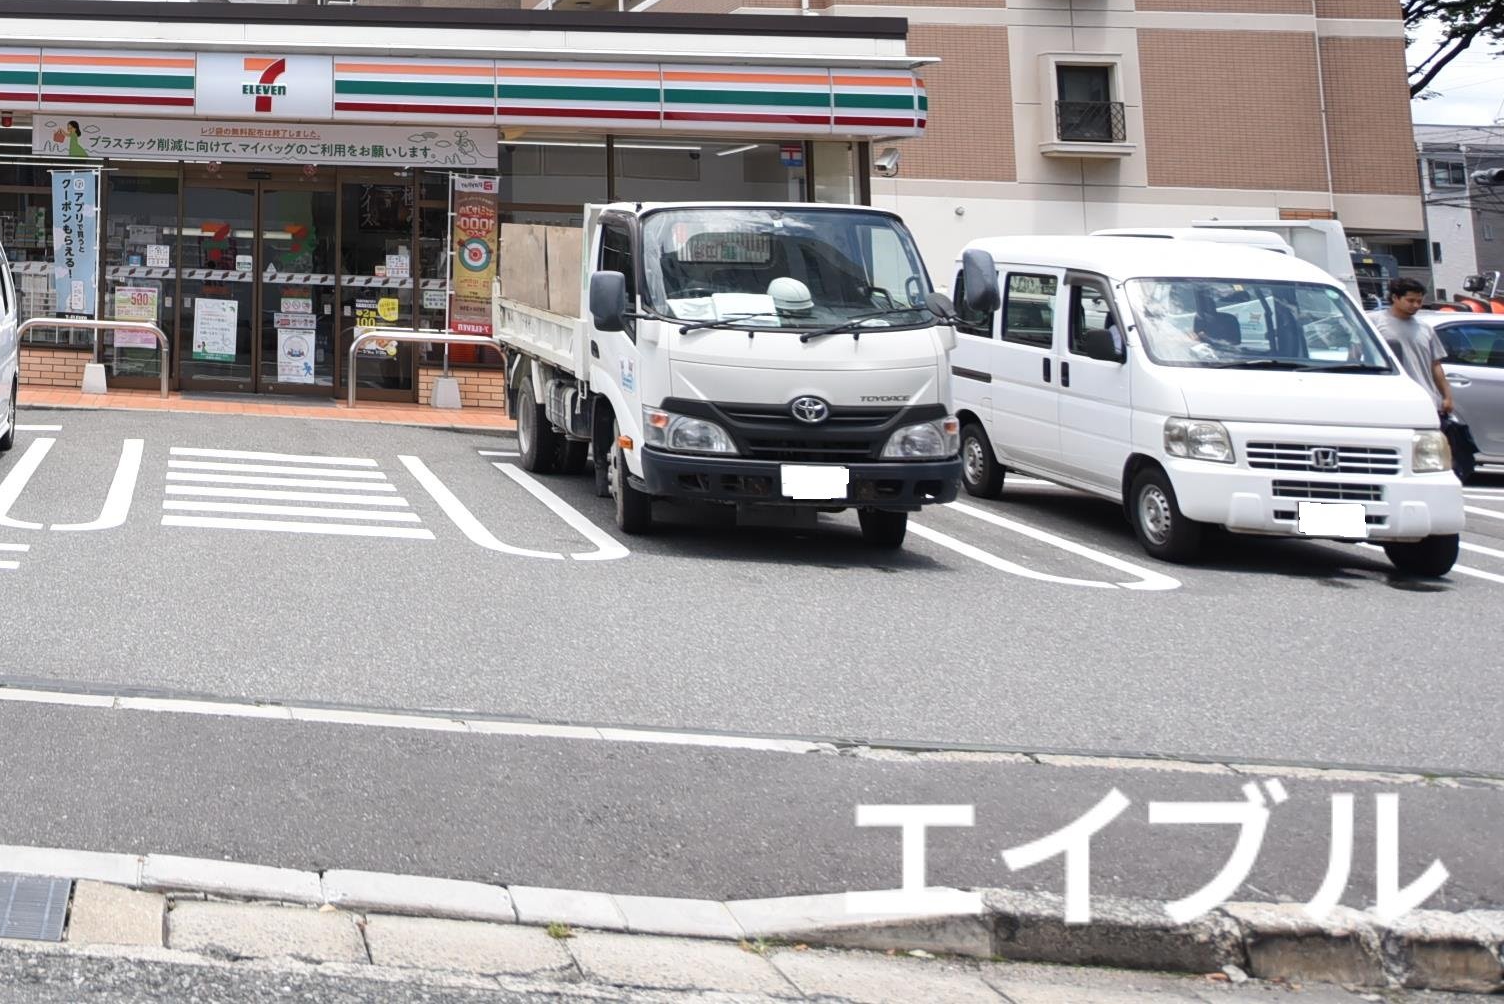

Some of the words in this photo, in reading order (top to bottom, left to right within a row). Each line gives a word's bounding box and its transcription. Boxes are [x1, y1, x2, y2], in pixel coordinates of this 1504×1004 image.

[89, 136, 437, 159] プラスチック削減に向けて、マイバッグのご利用をお願いします。
[200, 127, 321, 138] レジ袋の無料配布は終了しました。
[61, 179, 75, 278] クーポンもらえる!
[74, 192, 85, 253] アプリで買うと
